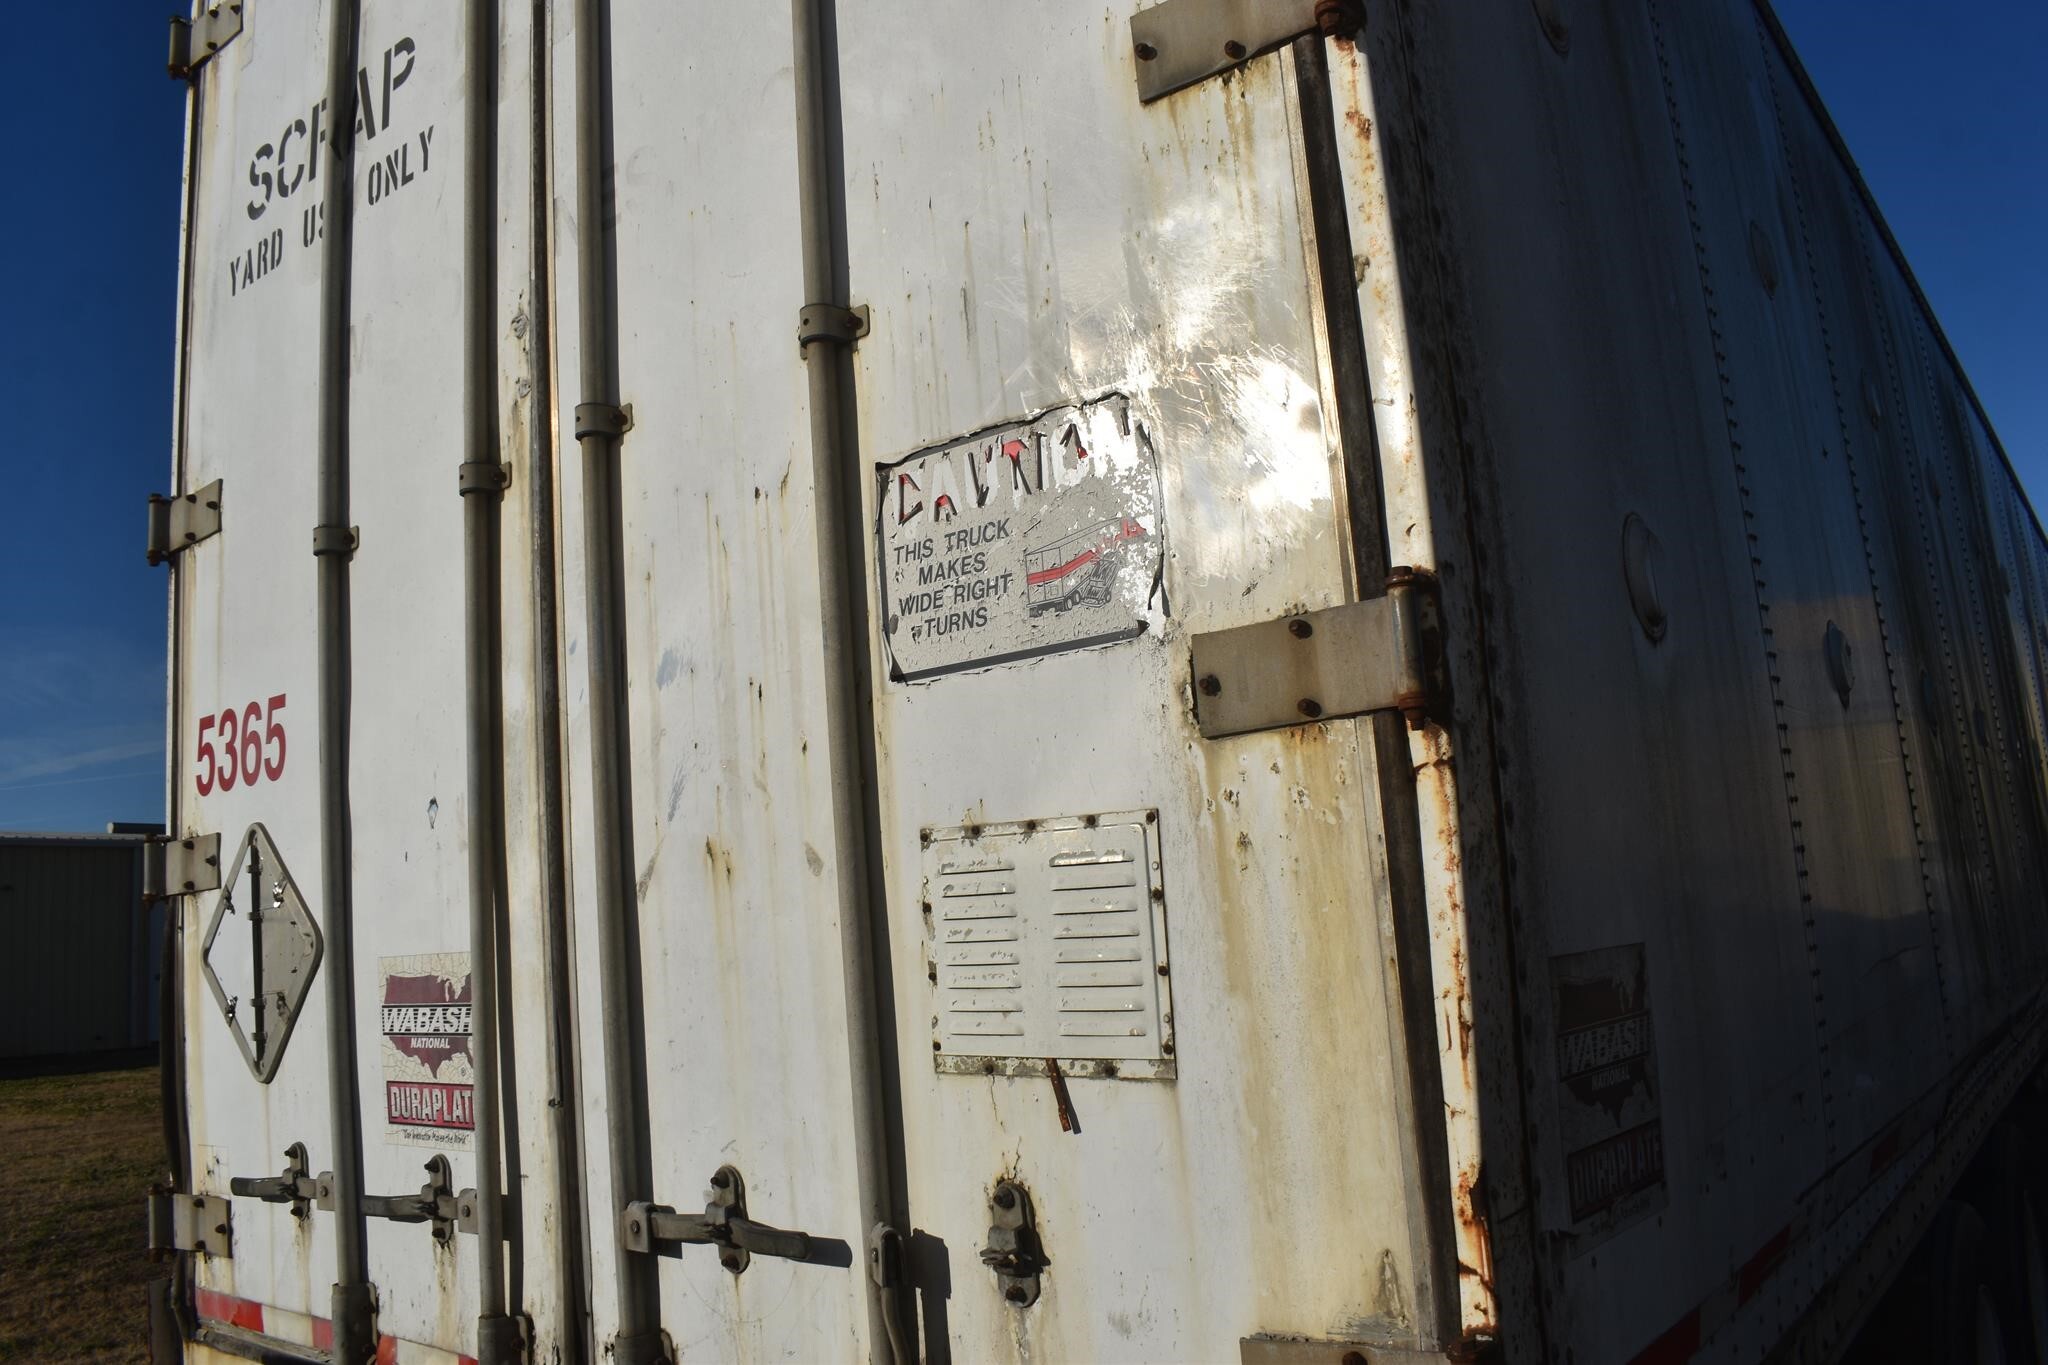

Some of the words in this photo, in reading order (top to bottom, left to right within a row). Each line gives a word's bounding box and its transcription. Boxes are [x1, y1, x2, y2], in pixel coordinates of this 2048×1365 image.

[229, 228, 284, 297] YARD
[367, 125, 434, 206] ONLY
[893, 538, 934, 565] THIS
[944, 517, 1011, 554] TRUCK
[918, 552, 986, 586] MAKES
[899, 591, 943, 617] WIDE
[953, 572, 1013, 602] RIGHT
[925, 606, 988, 638] TURNS
[196, 693, 286, 797] 5365
[410, 1037, 451, 1049] NATIONAL
[389, 1085, 474, 1123] DURAPLAT
